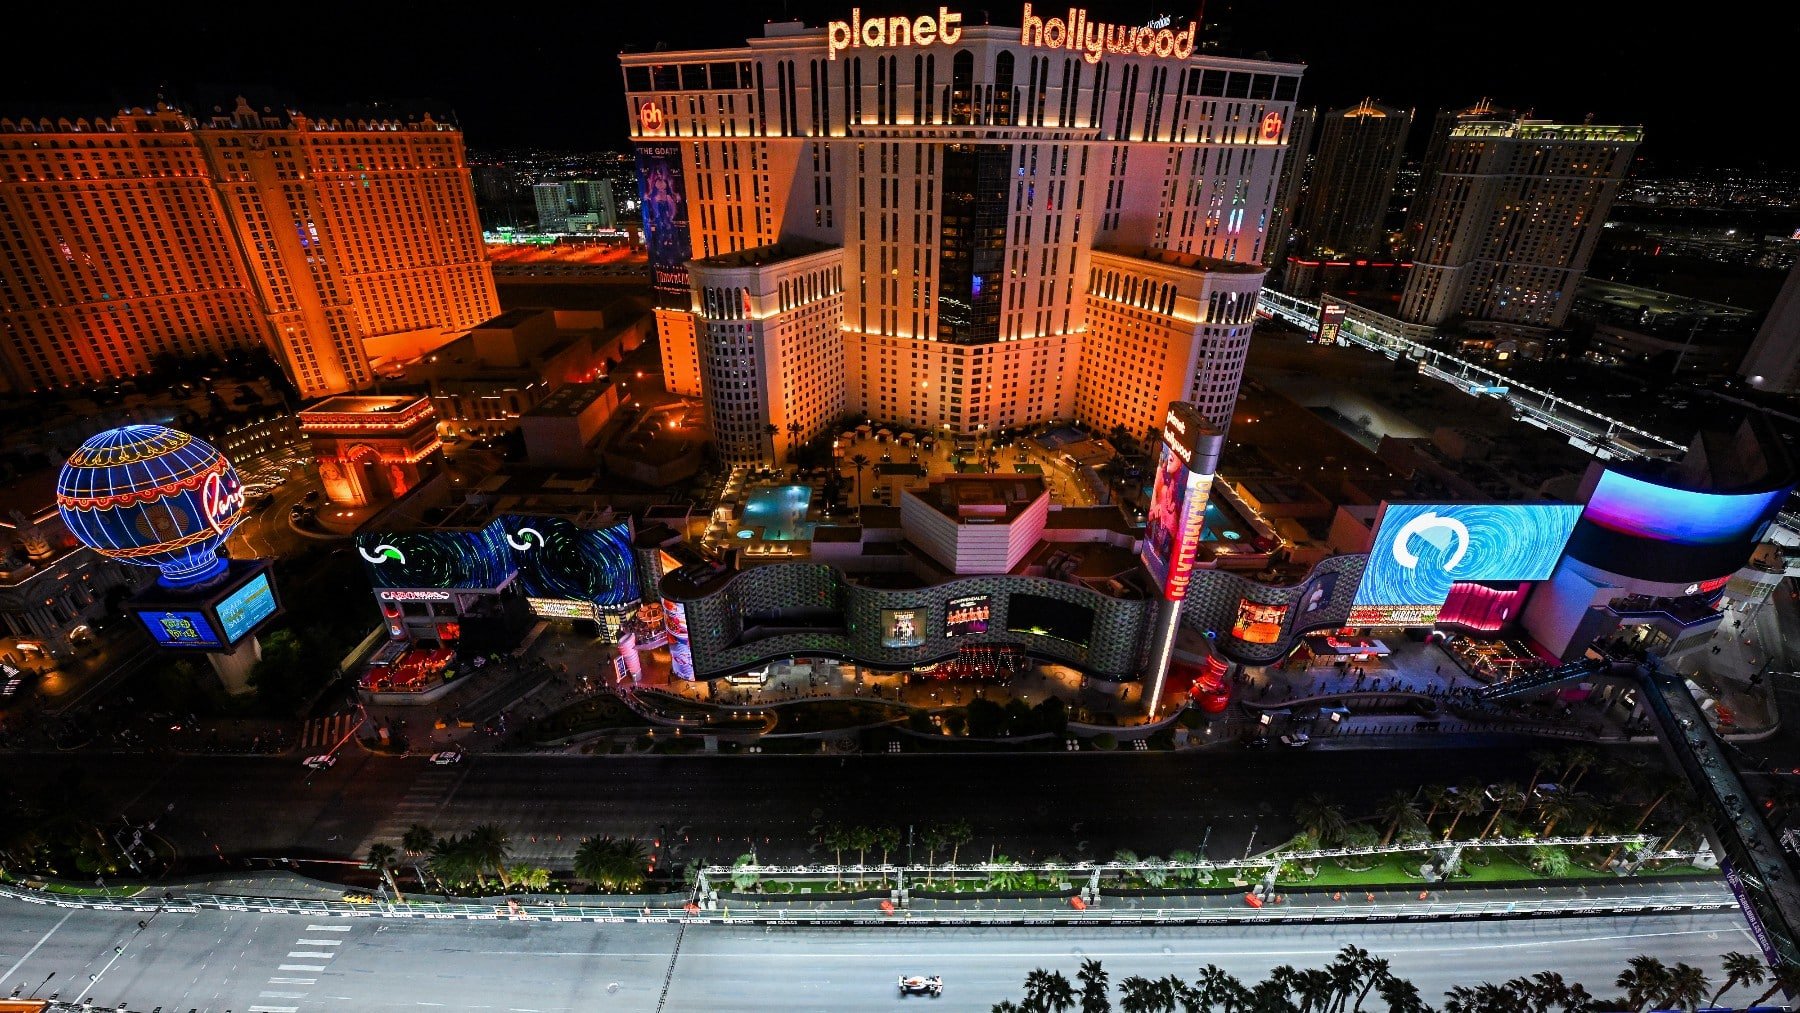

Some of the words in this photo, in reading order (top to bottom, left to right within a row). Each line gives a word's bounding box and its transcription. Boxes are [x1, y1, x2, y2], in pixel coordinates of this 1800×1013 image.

[828, 6, 962, 61] planet
[1021, 3, 1197, 63] hollywood
[1164, 426, 1192, 463] hollywood
[1167, 410, 1186, 435] planet
[203, 472, 245, 534] Paris
[1177, 480, 1212, 572] CARAMELLA
[1739, 894, 1757, 923] FABULOUS
[1752, 921, 1762, 934] LAS
[1757, 931, 1771, 952] VEGAS
